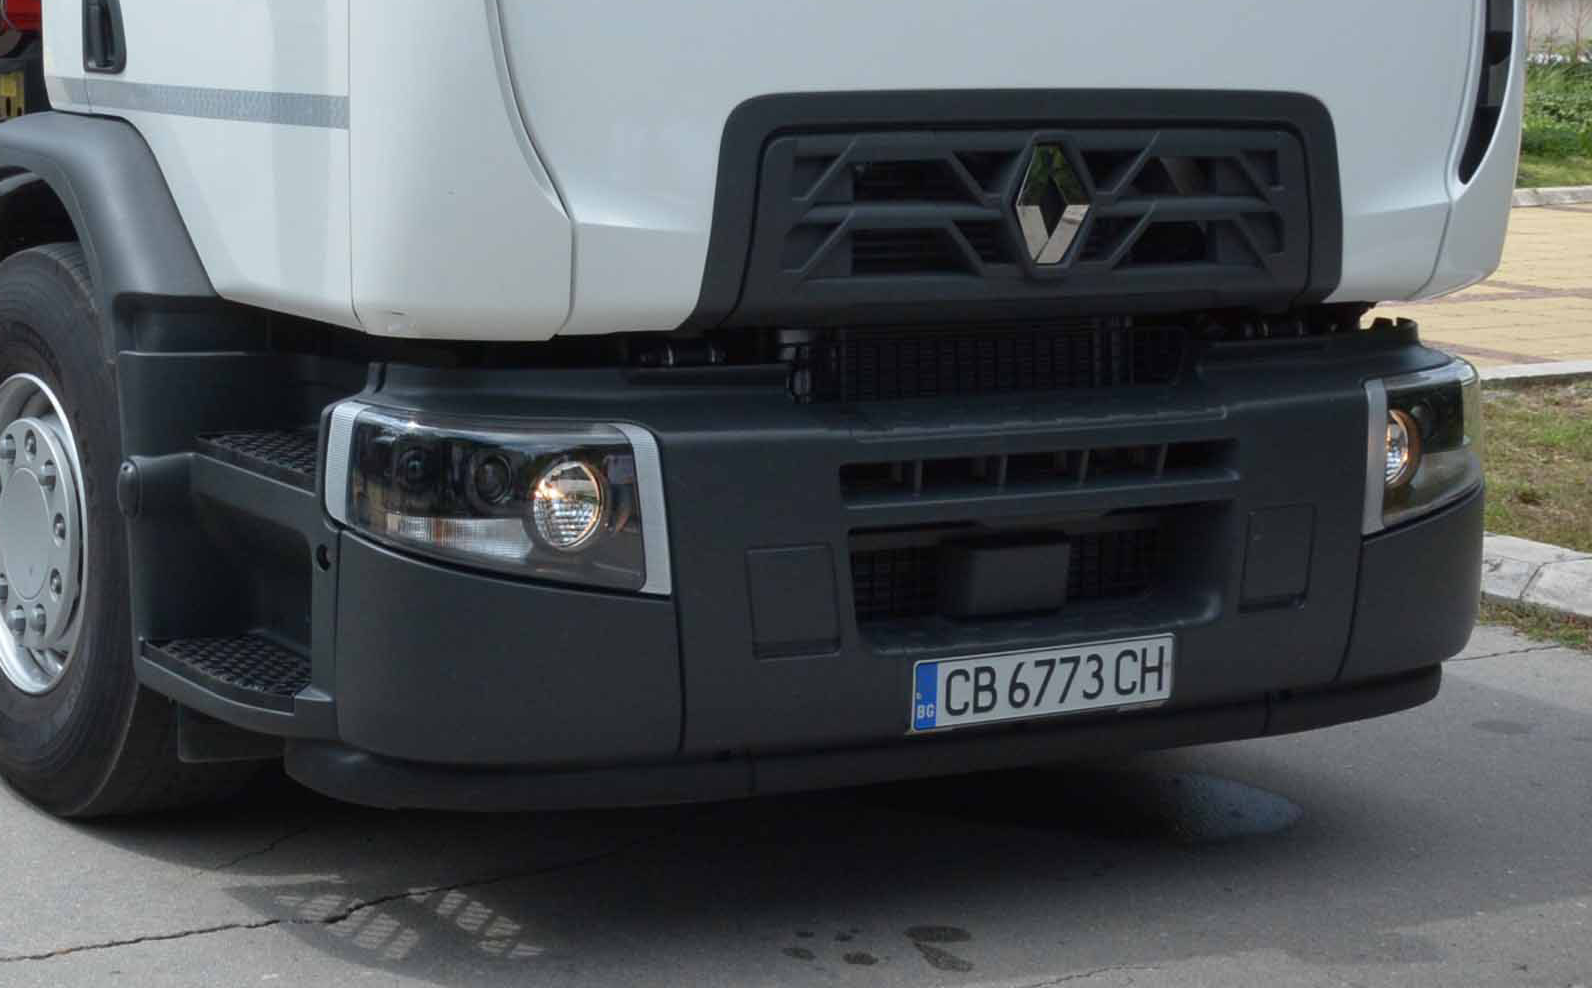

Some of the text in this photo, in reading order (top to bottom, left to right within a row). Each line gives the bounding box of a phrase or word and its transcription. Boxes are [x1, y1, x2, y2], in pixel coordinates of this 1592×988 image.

[944, 645, 1165, 716] CB 6773 CH
[916, 703, 936, 719] BG
